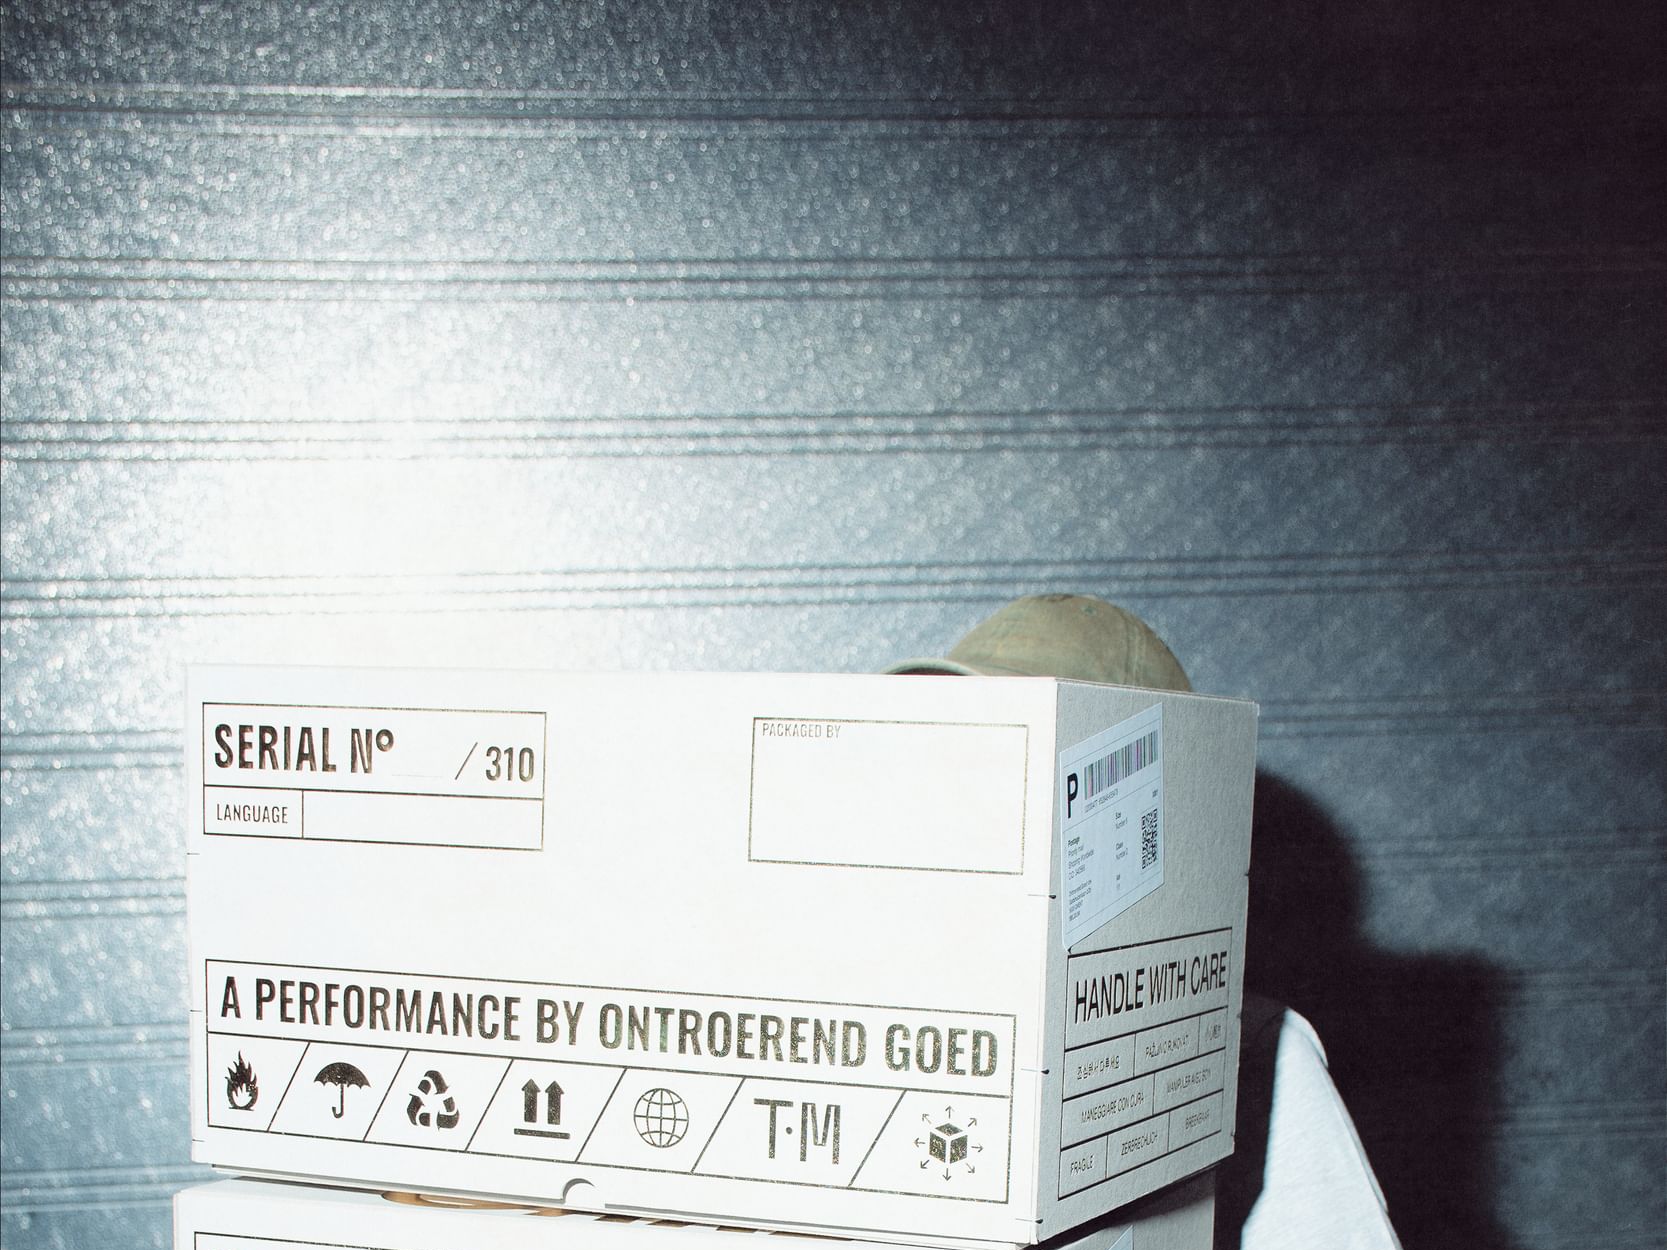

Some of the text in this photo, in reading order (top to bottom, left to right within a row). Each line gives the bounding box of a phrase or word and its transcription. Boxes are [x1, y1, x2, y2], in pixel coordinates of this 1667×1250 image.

[214, 723, 337, 773] SERIAL
[485, 746, 536, 782] 310
[762, 722, 841, 738] PACKAGED BY
[216, 802, 289, 825] LANGUAGE
[1067, 772, 1078, 819] P
[1074, 951, 1228, 1024] HANDLE WITH CARE
[220, 976, 998, 1078] A PERFORMANCE BY ONTROEREND GOED
[1070, 1154, 1094, 1175] FRAGILE
